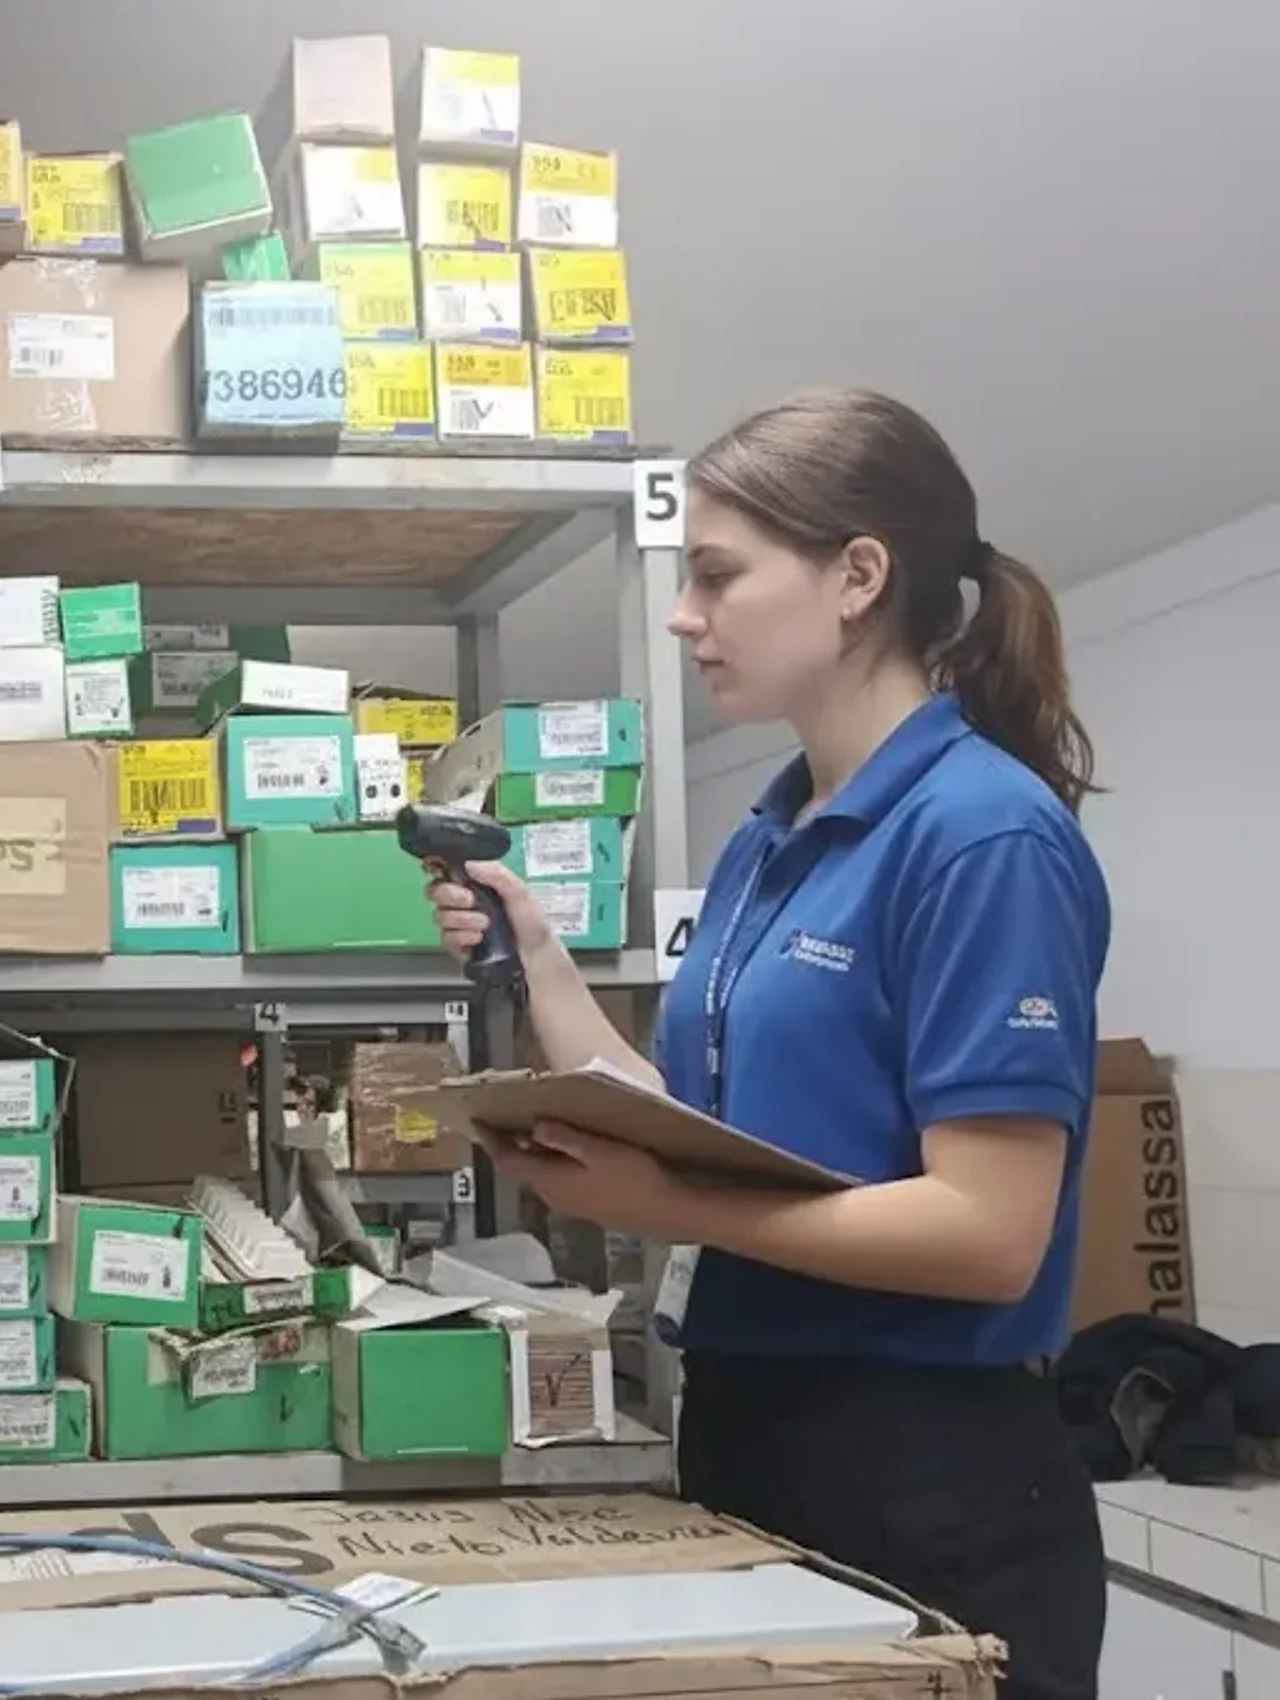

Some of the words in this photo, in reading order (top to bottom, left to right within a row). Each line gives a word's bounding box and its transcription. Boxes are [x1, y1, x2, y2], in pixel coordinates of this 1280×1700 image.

[646, 471, 677, 521] 5
[665, 917, 694, 957] 4
[259, 1000, 279, 1026] 4
